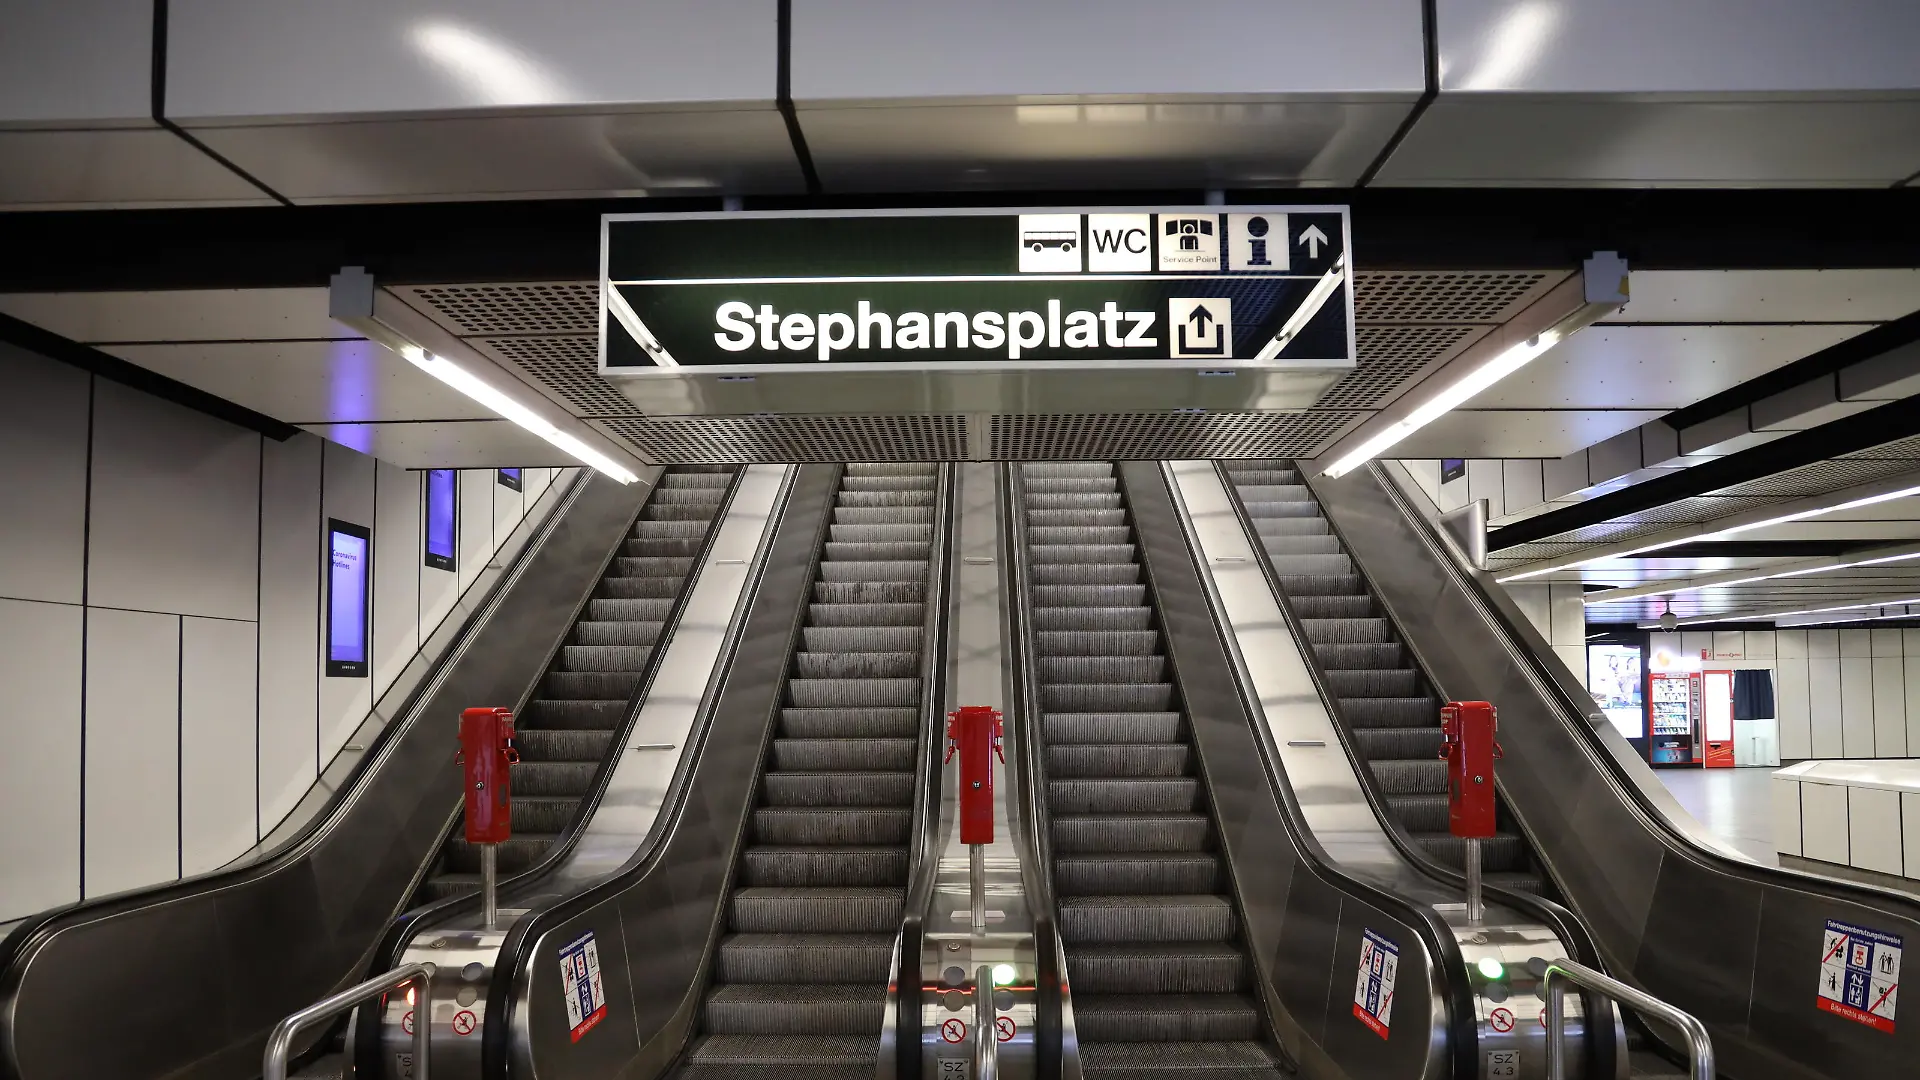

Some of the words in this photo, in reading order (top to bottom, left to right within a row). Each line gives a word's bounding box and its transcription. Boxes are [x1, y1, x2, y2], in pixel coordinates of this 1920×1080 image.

[1092, 228, 1147, 254] WC
[1163, 255, 1193, 263] Service
[1196, 255, 1217, 263] Point
[714, 299, 1158, 361] Stephansplatz
[1494, 1054, 1513, 1064] SZ
[944, 1062, 964, 1072] SZ
